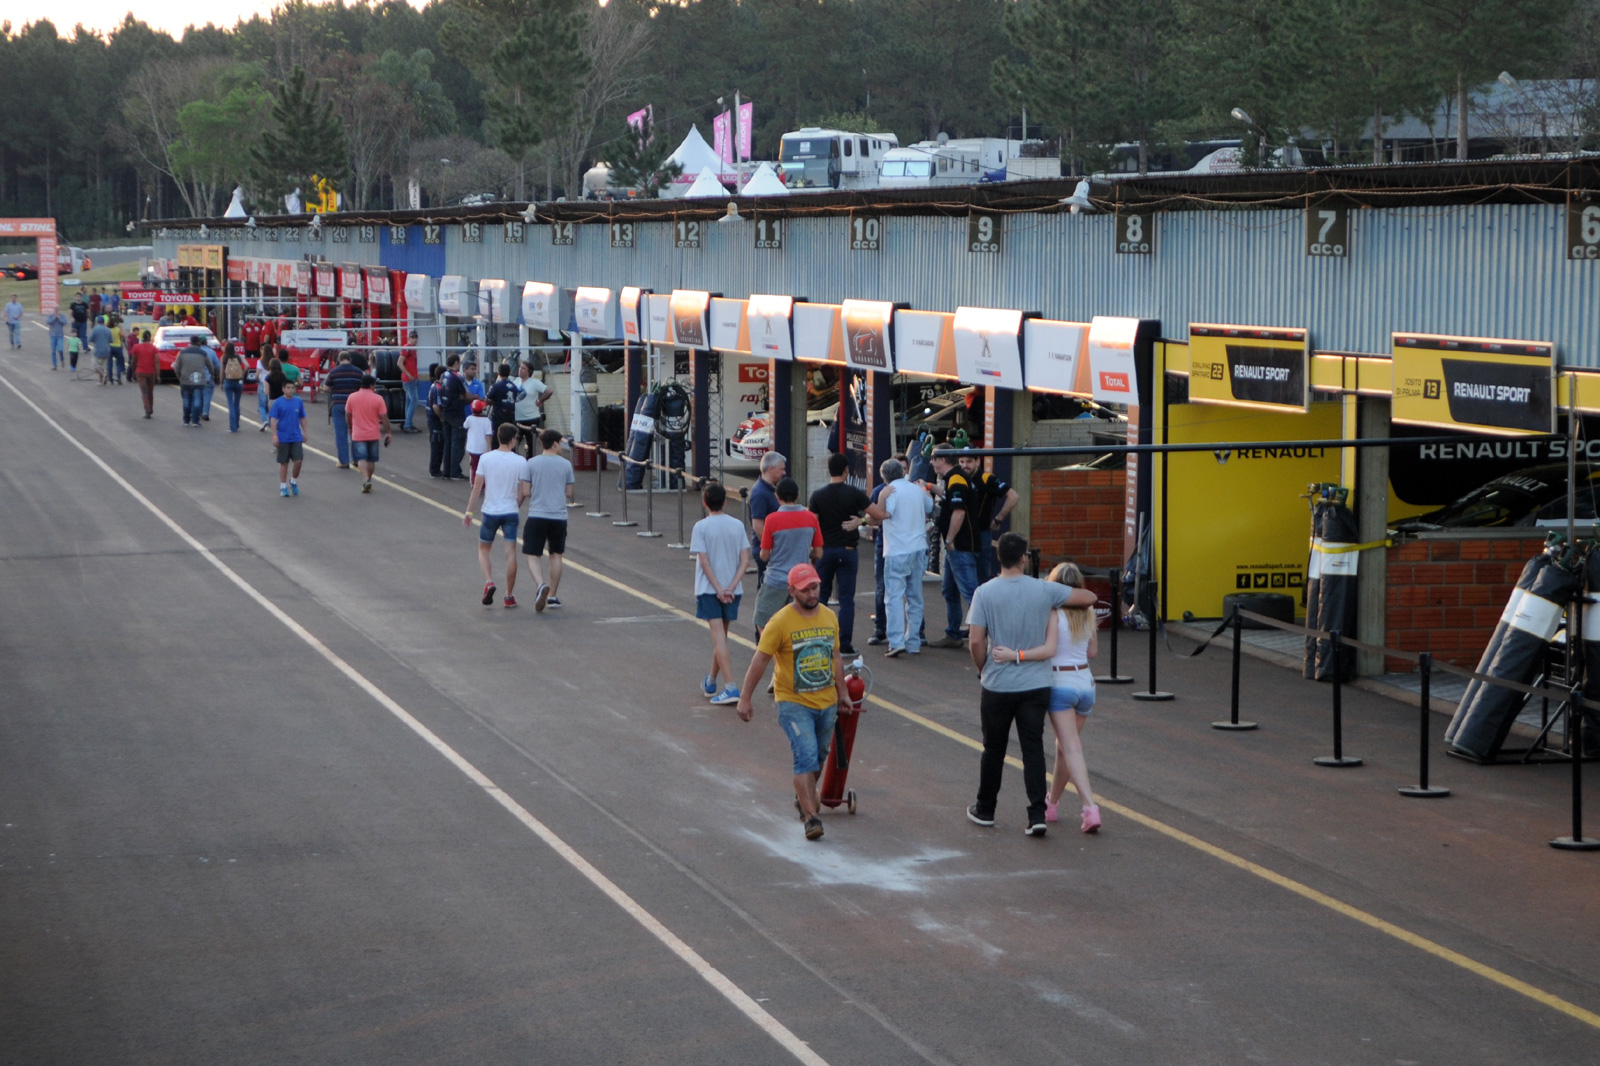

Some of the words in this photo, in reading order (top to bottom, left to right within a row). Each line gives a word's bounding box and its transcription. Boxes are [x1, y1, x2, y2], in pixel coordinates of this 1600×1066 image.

[20, 223, 54, 232] STIHL
[332, 226, 347, 238] 20
[361, 226, 374, 238] 19
[390, 225, 406, 239] 18
[424, 225, 440, 239] 17
[464, 223, 480, 237] 16
[505, 222, 522, 237] 15
[554, 222, 573, 239] 14
[612, 223, 633, 240] 13
[677, 221, 699, 240] 12
[758, 220, 780, 240] 11
[853, 218, 879, 241] 10
[978, 216, 993, 242] 9
[1126, 214, 1143, 242] 8
[1318, 210, 1336, 243] 7
[1582, 206, 1600, 244] 6
[265, 228, 278, 238] 23
[285, 227, 299, 238] 22
[853, 241, 877, 249] aco
[972, 243, 999, 251] aco
[1119, 242, 1149, 252] aco
[1310, 243, 1344, 255] aco
[1572, 245, 1600, 258] ac
[1212, 364, 1223, 378] 22
[1234, 364, 1266, 379] RENAULT
[1265, 366, 1290, 381] SPORT
[1104, 375, 1125, 388] TOTAL
[920, 388, 934, 399] 79
[1426, 381, 1438, 397] 13
[1453, 381, 1496, 399] RENAULT
[1496, 386, 1531, 402] SPORT
[1420, 441, 1543, 459] RENAULT
